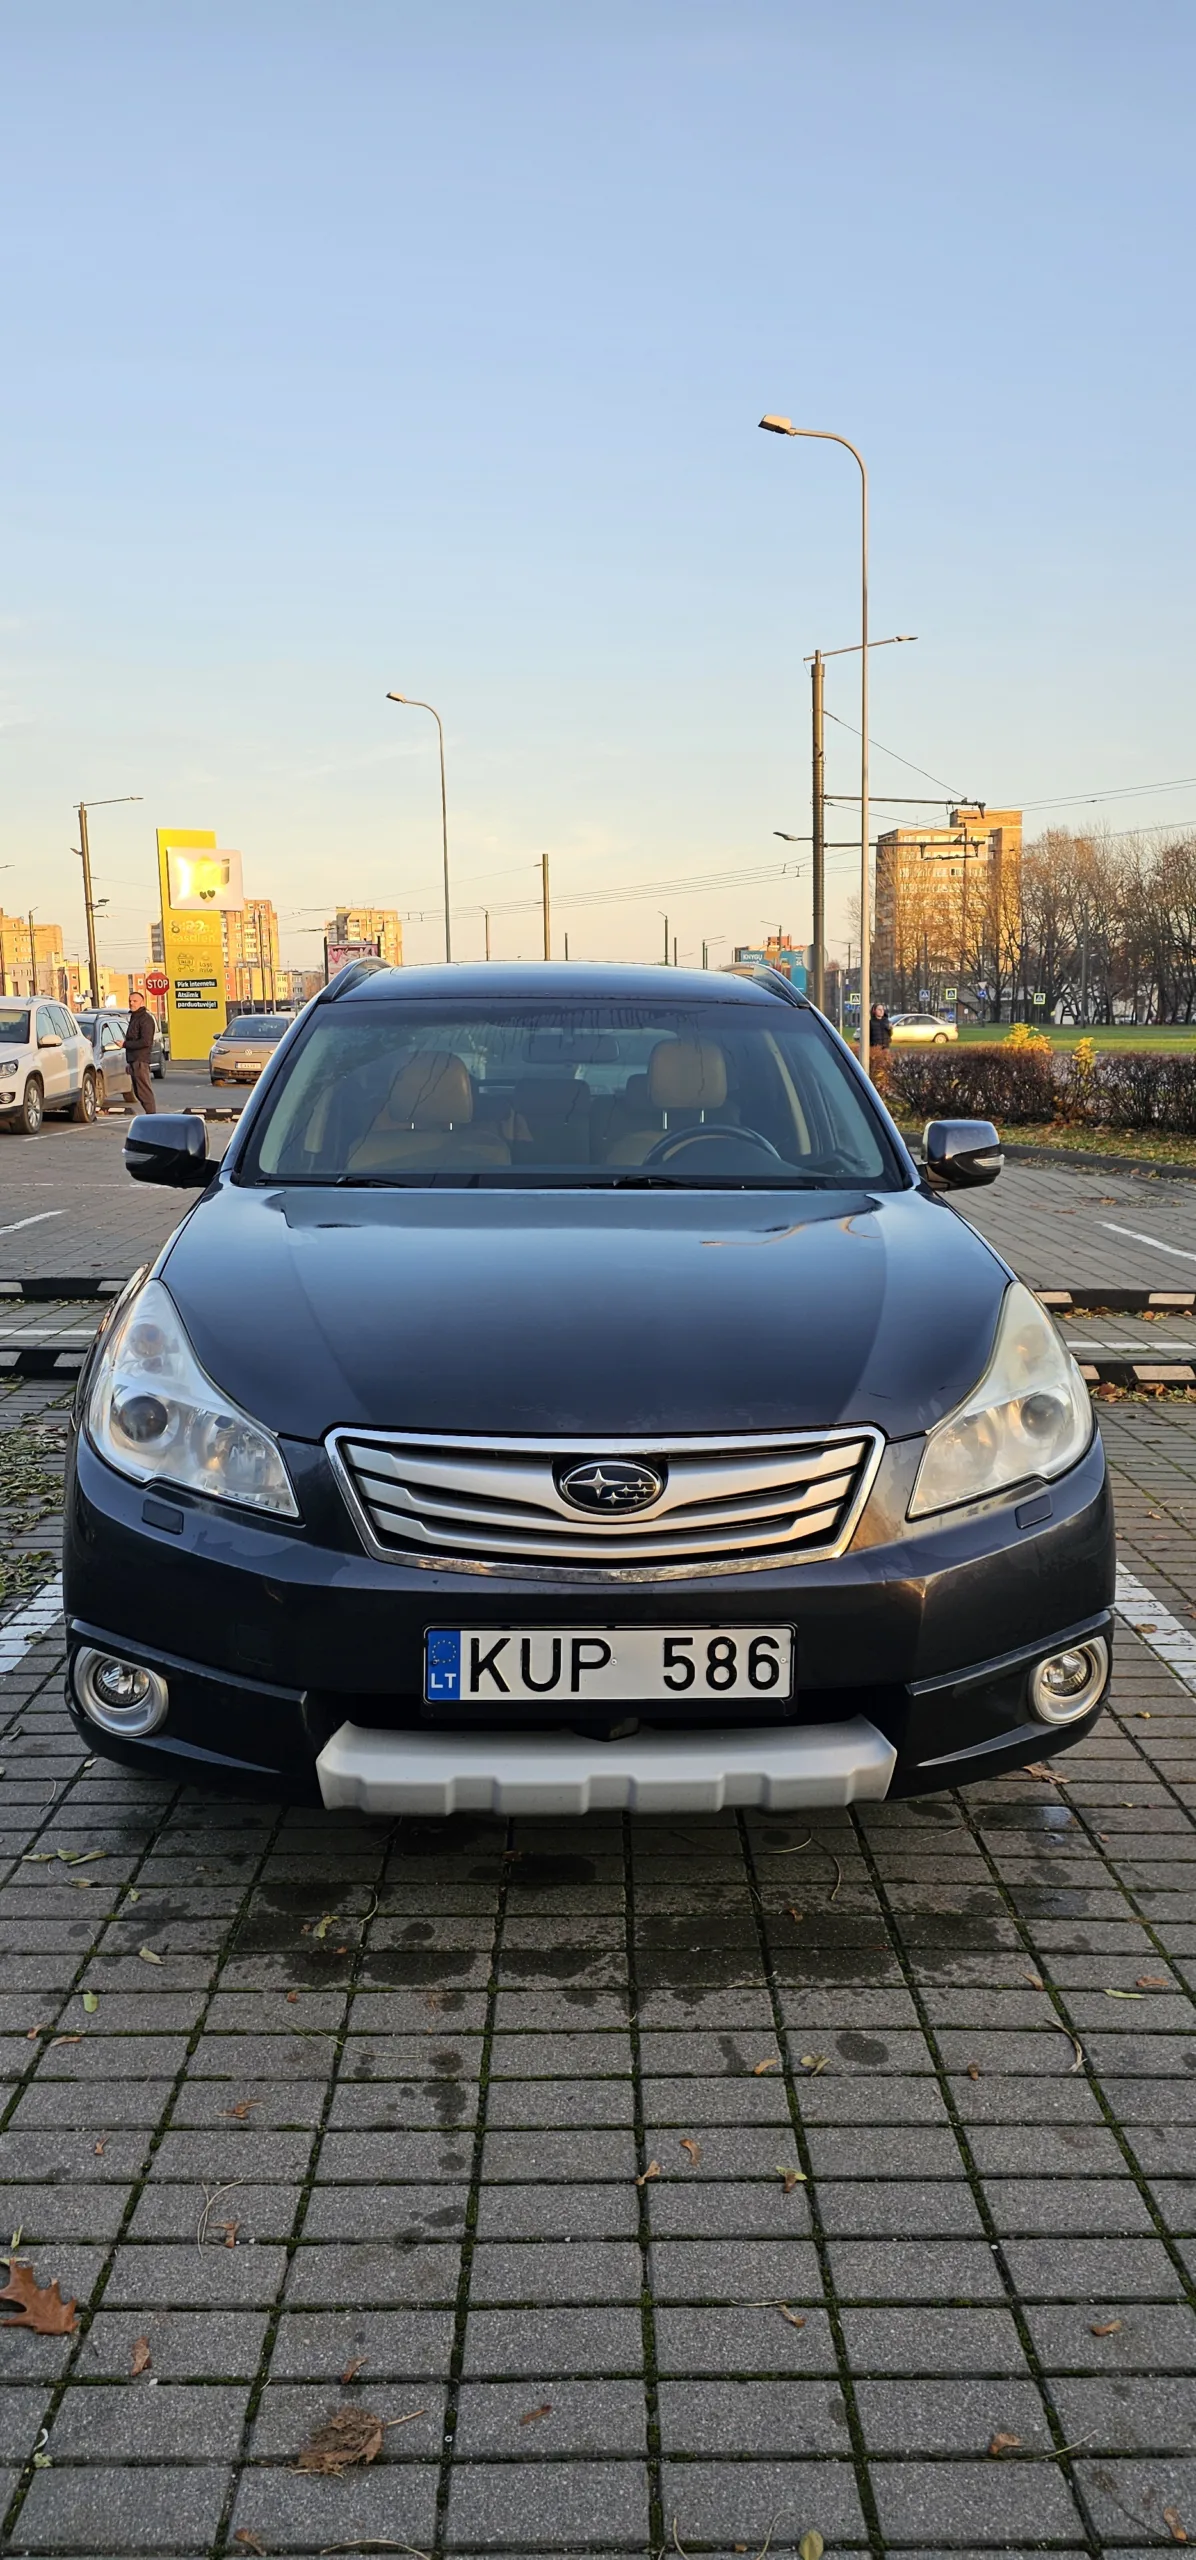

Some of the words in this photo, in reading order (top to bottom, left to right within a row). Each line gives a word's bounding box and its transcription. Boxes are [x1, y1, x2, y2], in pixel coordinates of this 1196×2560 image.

[147, 979, 168, 989] STOP
[430, 1672, 457, 1689] LT
[469, 1636, 612, 1693] KUP
[663, 1635, 780, 1692] 586
